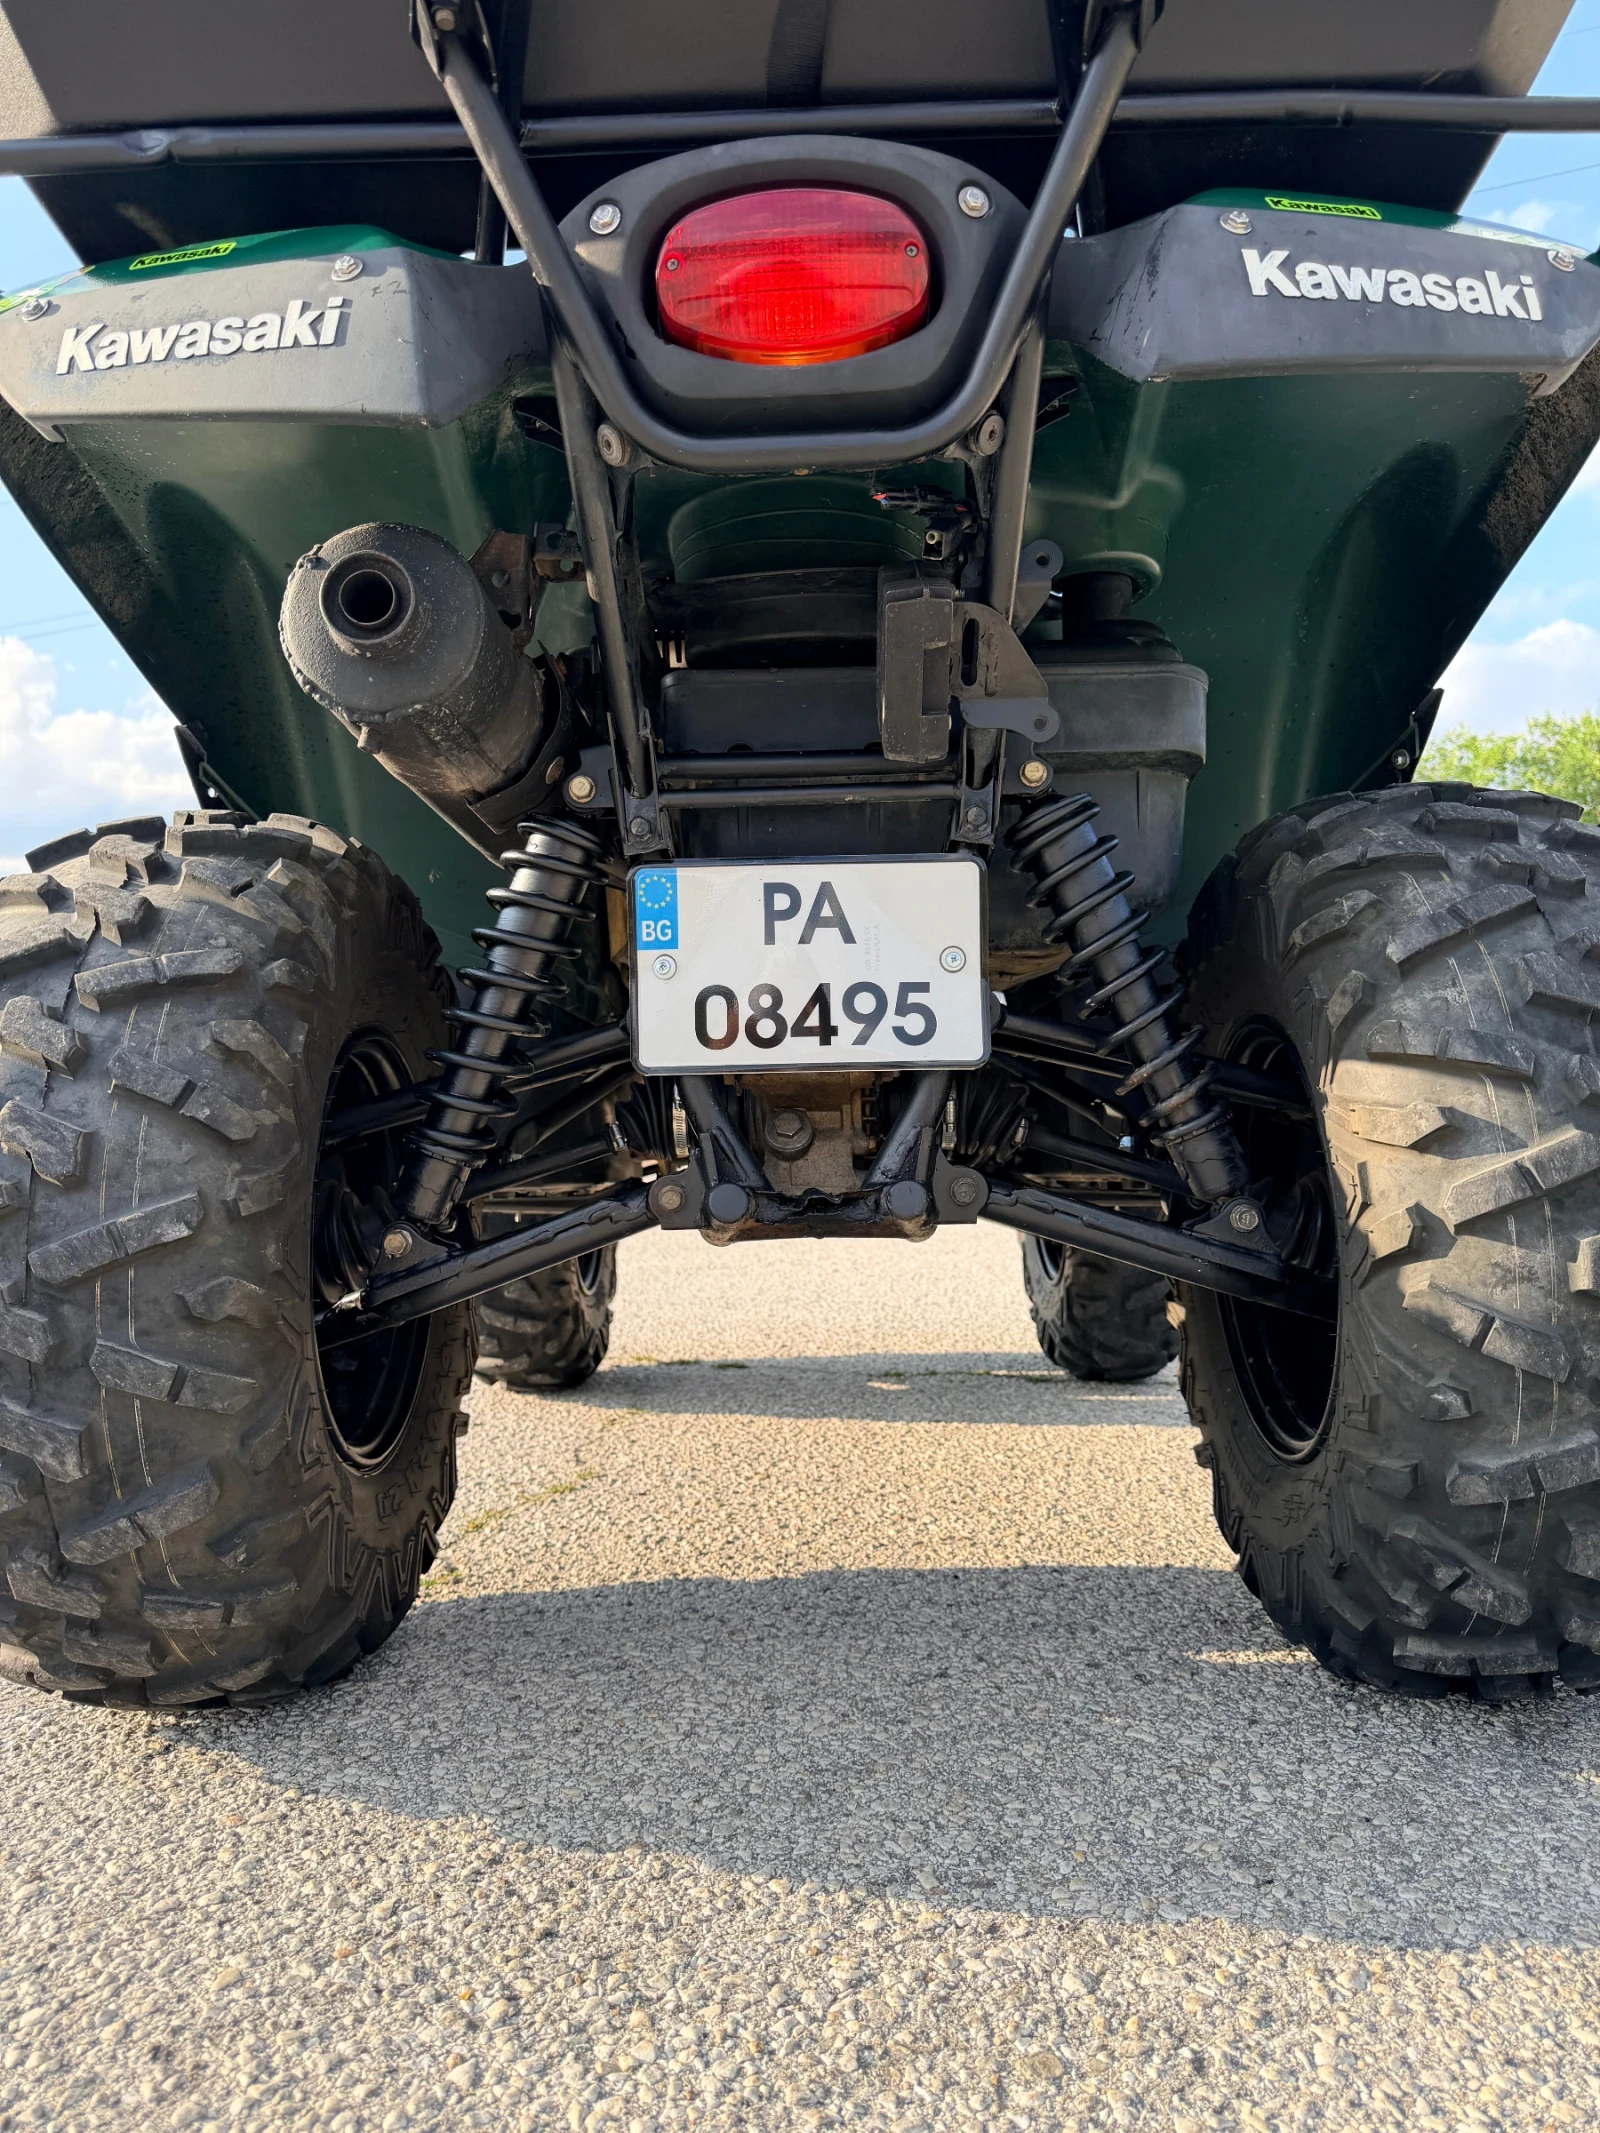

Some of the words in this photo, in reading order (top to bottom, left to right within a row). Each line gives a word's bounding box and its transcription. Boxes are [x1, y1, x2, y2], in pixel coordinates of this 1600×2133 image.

[1268, 198, 1378, 217] Kawasaki
[131, 244, 233, 268] Kawasaki
[1241, 249, 1543, 321] Kawasaki
[55, 297, 344, 375] Kawasaki
[641, 919, 672, 942] BG
[763, 881, 857, 946] PA
[694, 981, 938, 1051] 08495
